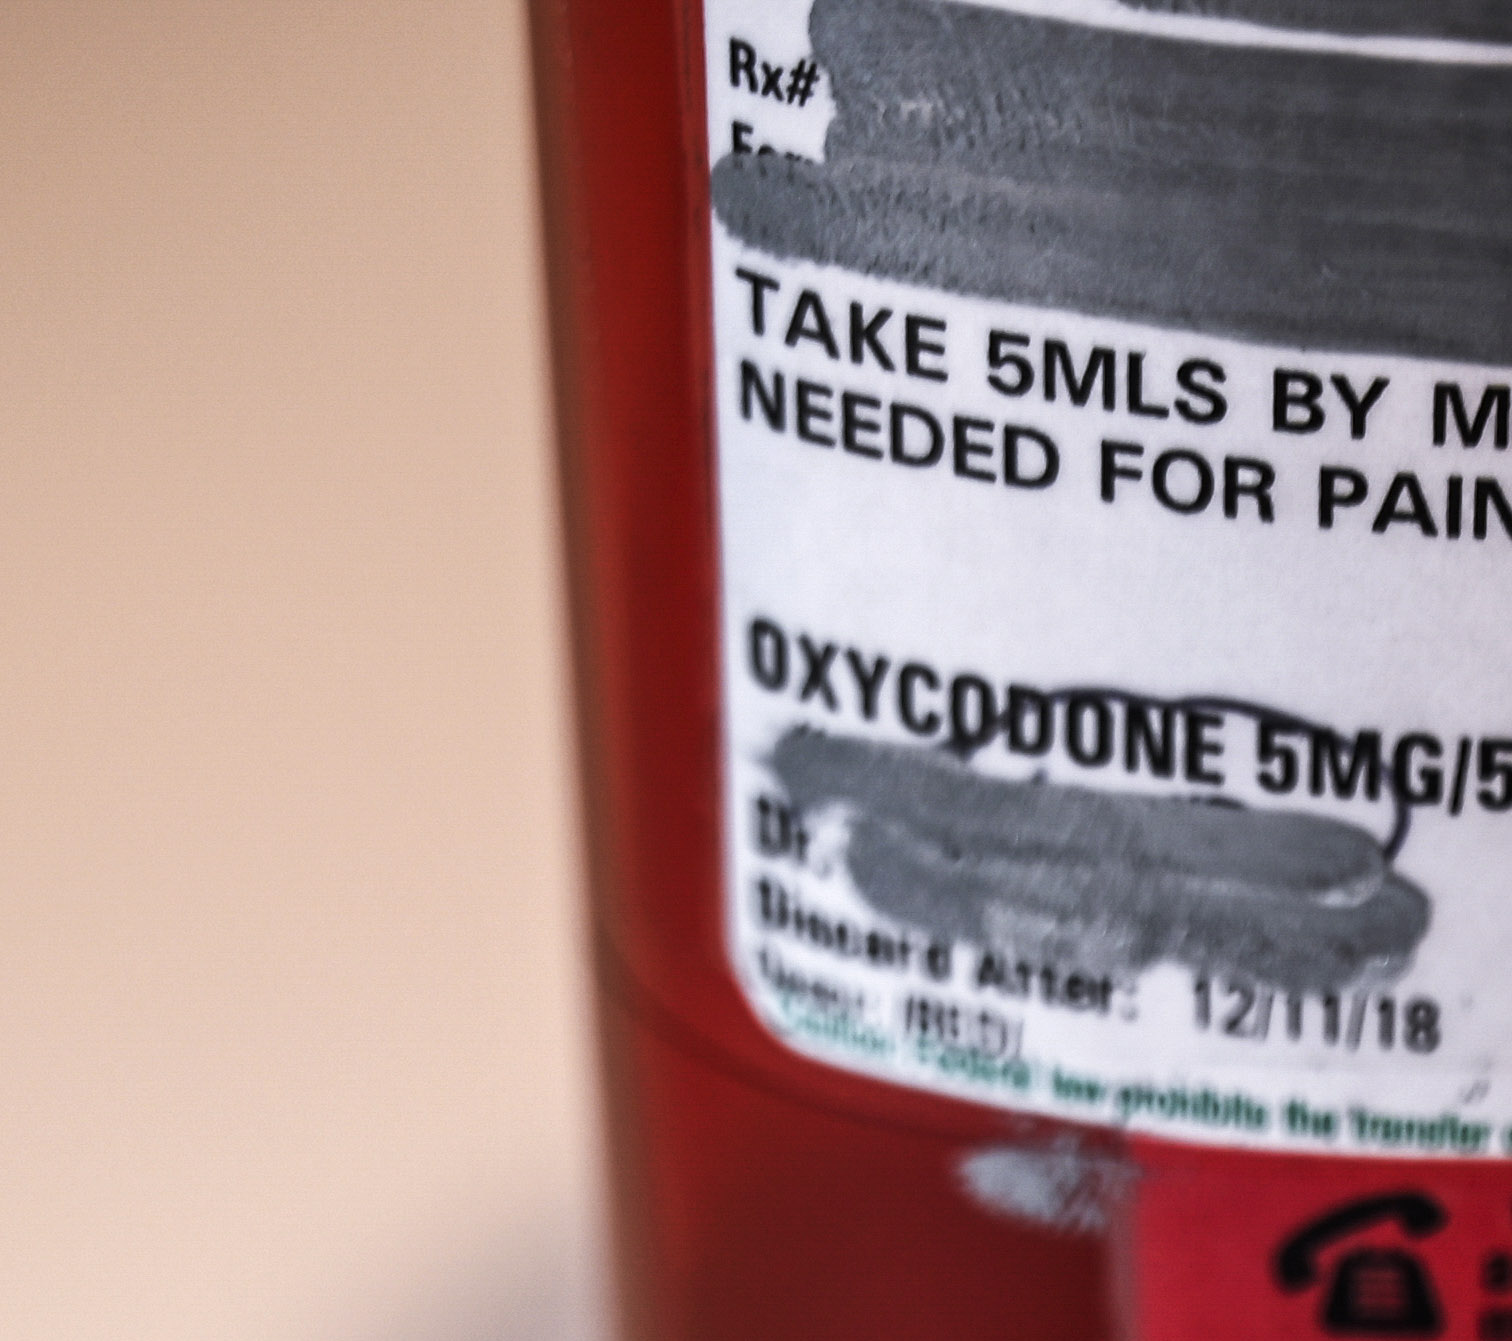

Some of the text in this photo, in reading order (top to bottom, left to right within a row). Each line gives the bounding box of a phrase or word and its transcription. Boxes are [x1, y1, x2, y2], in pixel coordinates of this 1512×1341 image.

[729, 35, 820, 107] Rx#
[735, 267, 948, 382] TAKE
[986, 334, 1229, 425] 5MLS
[1272, 368, 1391, 441] BY
[738, 361, 1061, 491] NEEDED
[1100, 441, 1276, 523] FOR
[746, 617, 1226, 789] OXYCODONE
[760, 876, 951, 984] Discard
[1194, 972, 1443, 1056] 12/11/18
